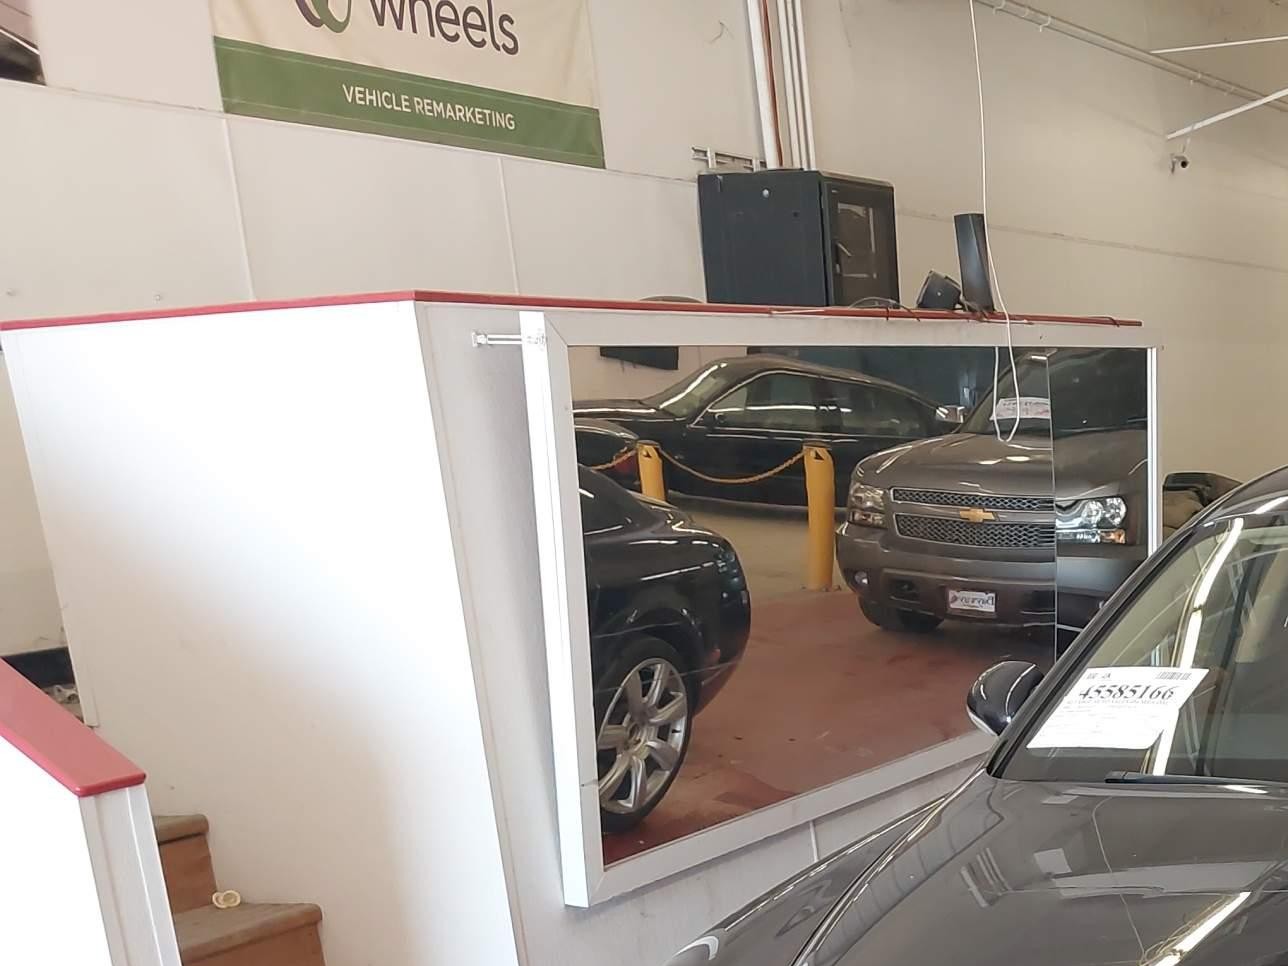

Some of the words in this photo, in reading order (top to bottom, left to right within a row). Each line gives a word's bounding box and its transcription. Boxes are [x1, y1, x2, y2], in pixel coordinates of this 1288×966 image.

[342, 83, 412, 113] VEHICLE
[413, 97, 516, 130] REMARKETING
[1078, 684, 1180, 700] 45585166
